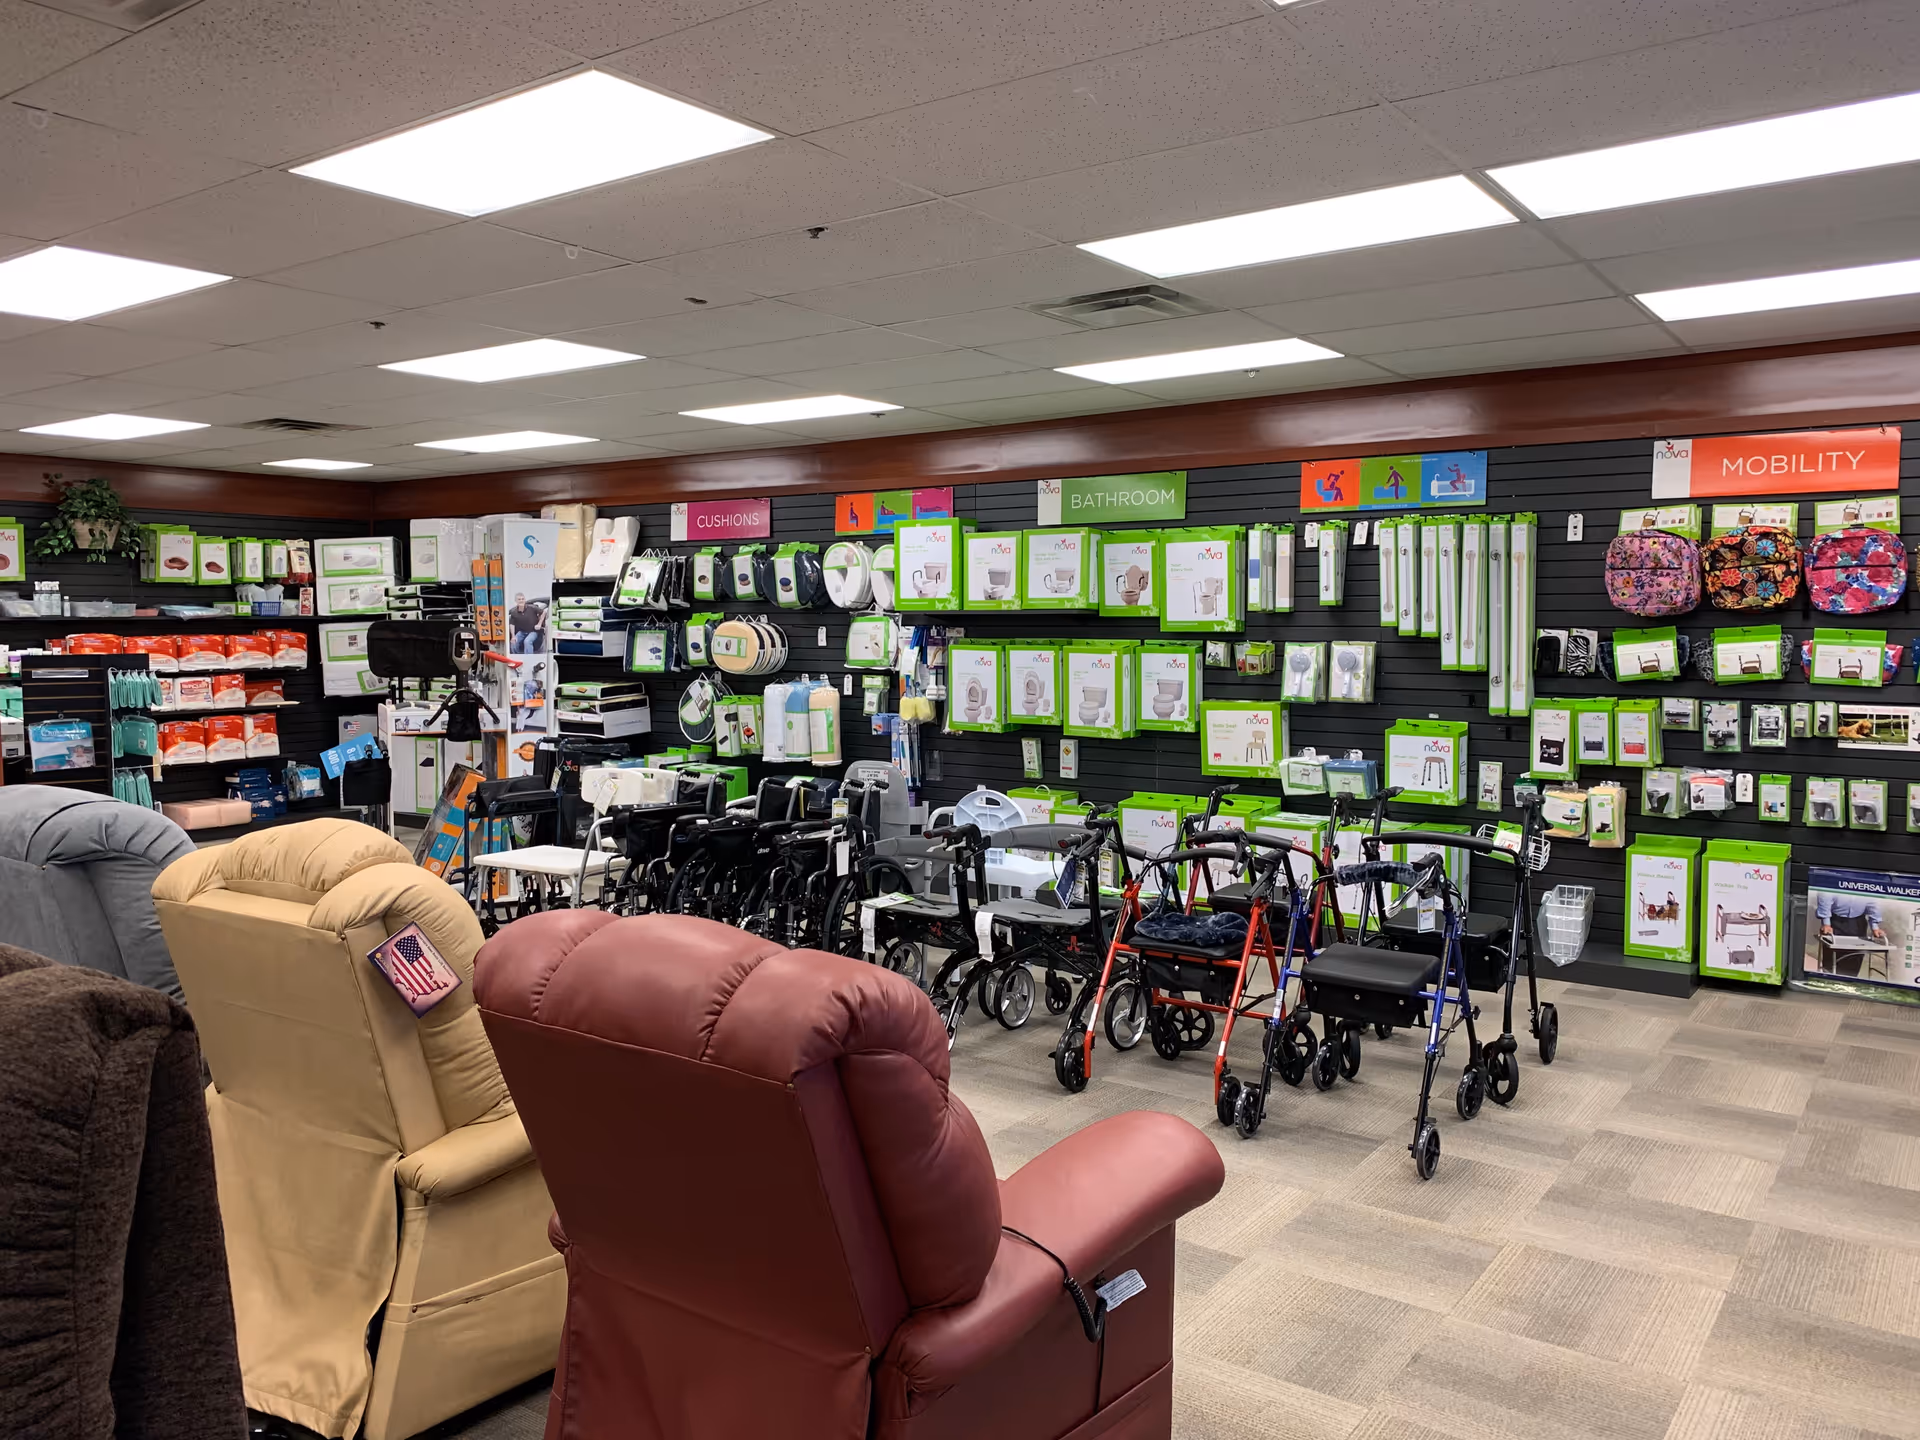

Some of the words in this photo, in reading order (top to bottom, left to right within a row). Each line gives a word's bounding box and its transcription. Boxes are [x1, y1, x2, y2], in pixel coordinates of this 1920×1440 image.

[1655, 447, 1689, 460] nova
[1721, 449, 1866, 477] MOBILITY
[1039, 485, 1060, 495] nova
[1071, 488, 1175, 509] BATHROOM
[696, 512, 760, 528] CUSHIONS
[925, 534, 946, 543] nova
[991, 545, 1011, 555] nova
[1054, 541, 1076, 550] nova
[1131, 547, 1148, 555] nova
[1197, 550, 1223, 561] nova
[515, 560, 547, 570] Stander
[974, 658, 992, 667] nova
[1032, 655, 1050, 663] nova
[1091, 660, 1110, 669] nova
[1166, 660, 1186, 669] nova
[1246, 716, 1269, 725] nova
[1424, 743, 1450, 753] nova
[1151, 819, 1175, 828] nova
[1663, 862, 1683, 870] nova
[1744, 871, 1773, 881] nova
[1838, 880, 1886, 893] UNIVERSAL
